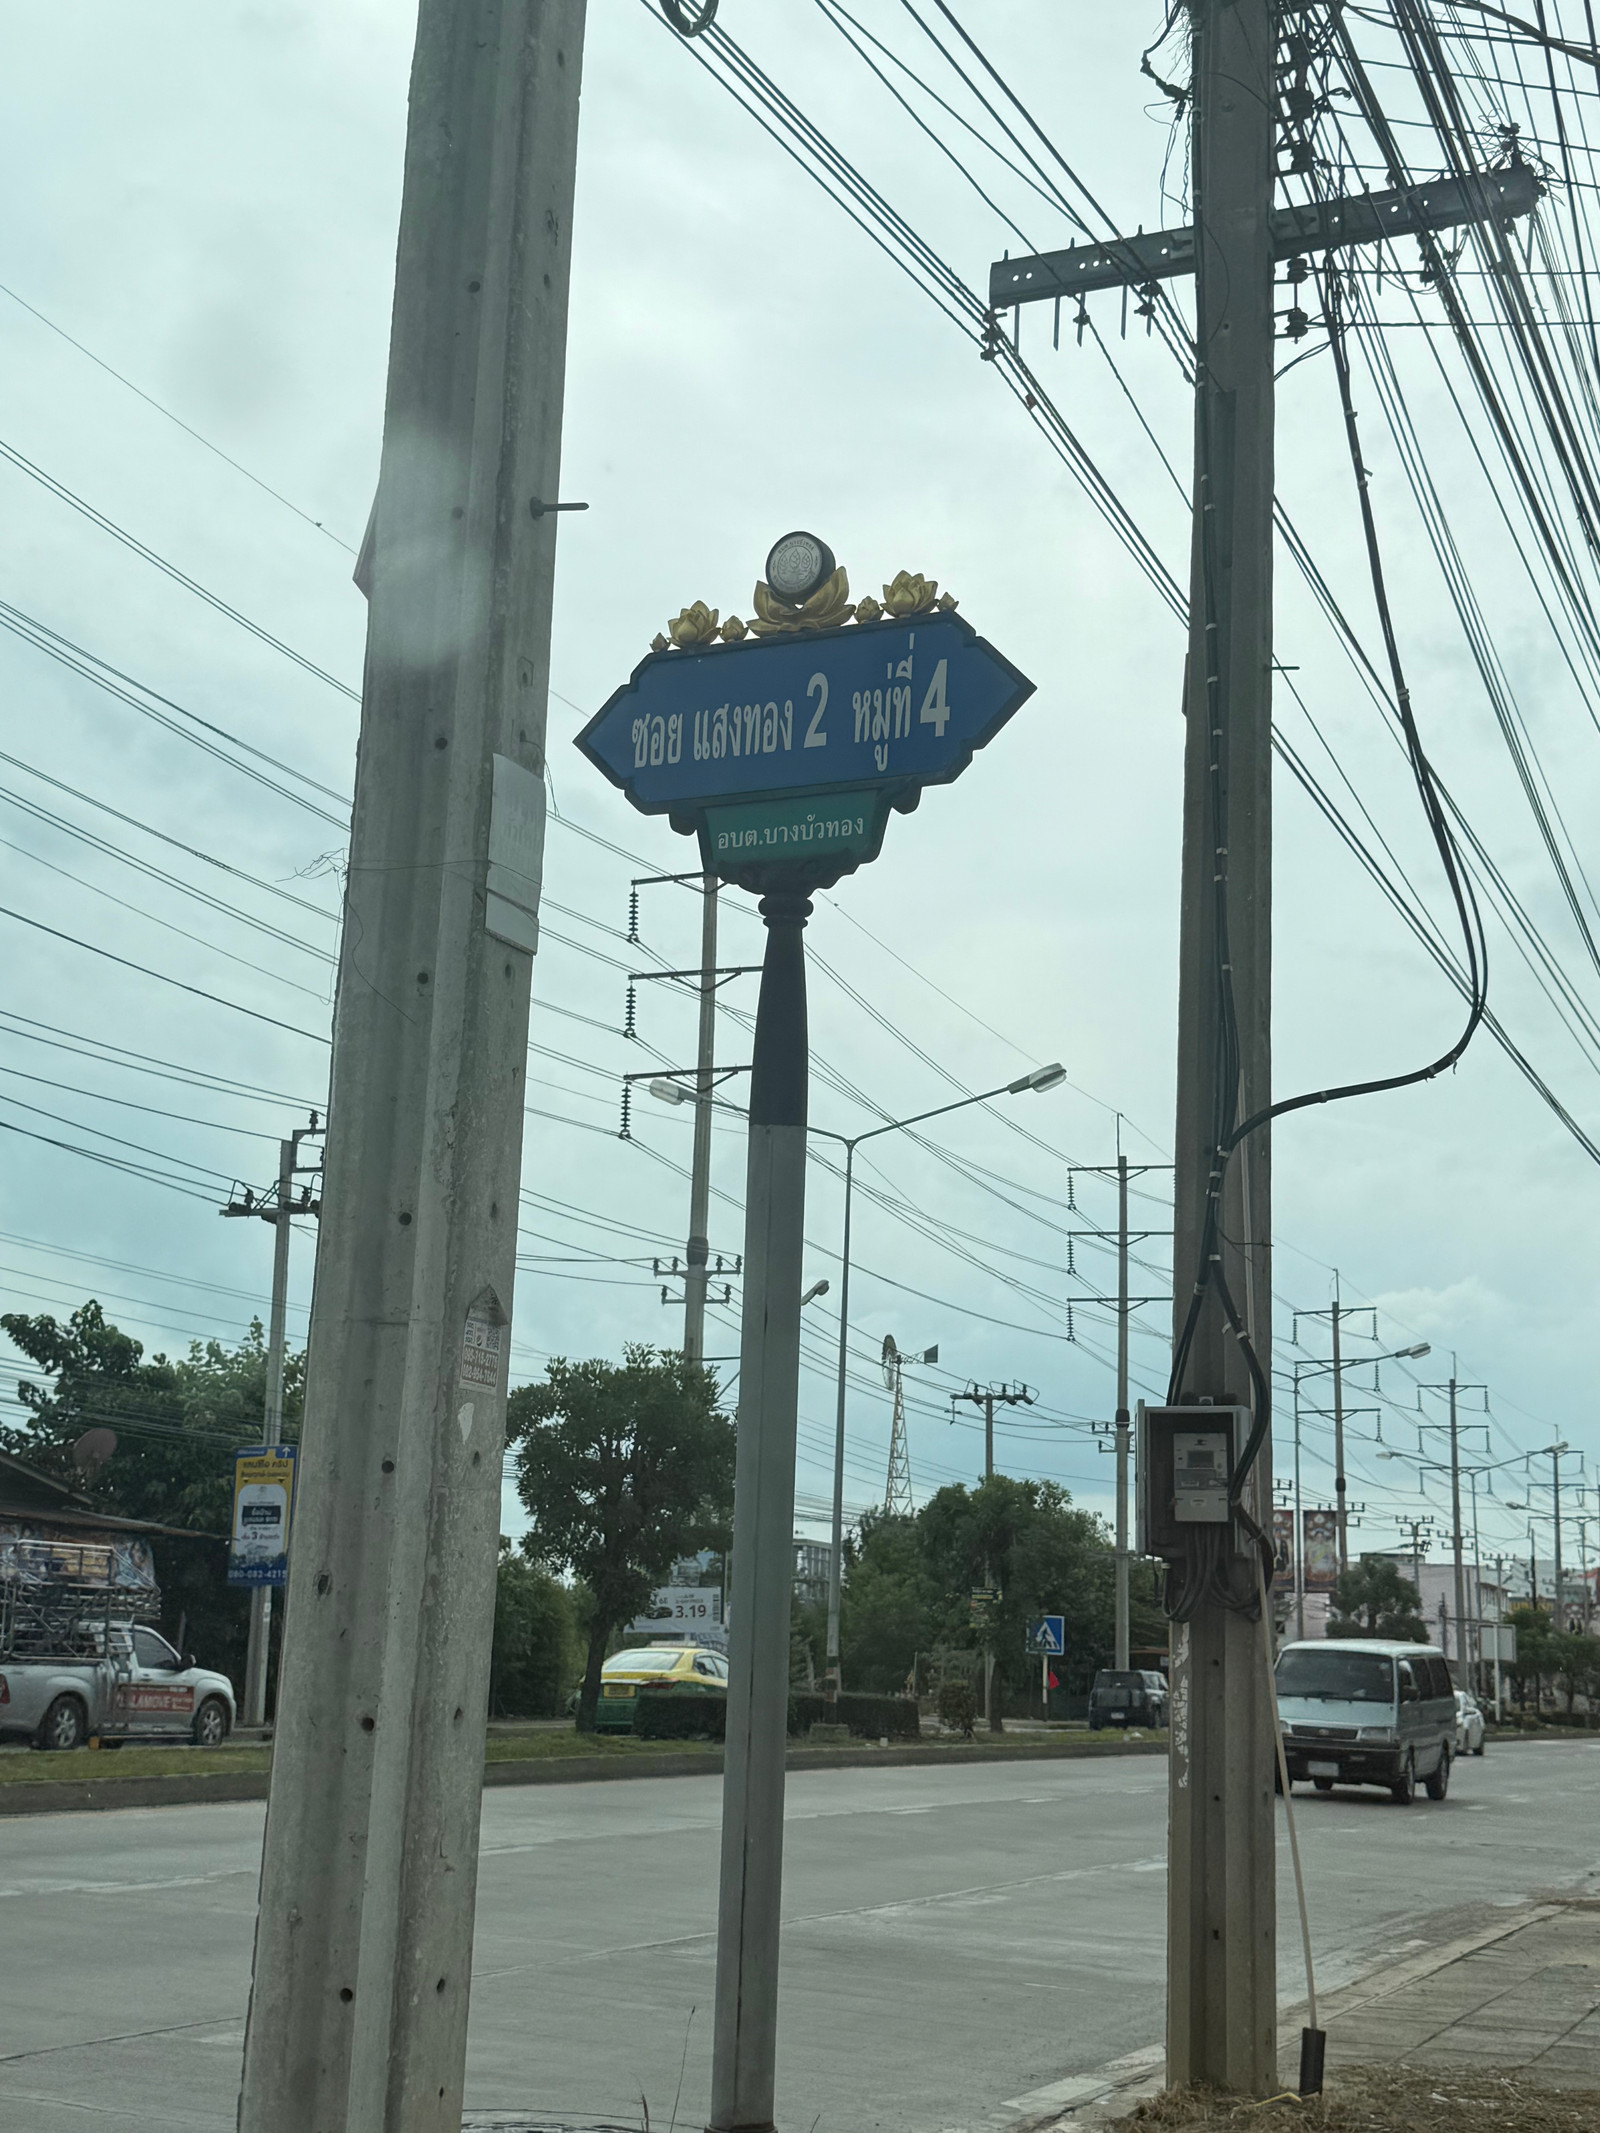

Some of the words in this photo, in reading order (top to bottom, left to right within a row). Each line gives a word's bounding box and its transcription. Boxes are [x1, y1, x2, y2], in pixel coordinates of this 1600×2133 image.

[631, 712, 683, 769] ซอย
[693, 699, 793, 761] แสงทอง
[803, 672, 829, 749] 2
[852, 632, 915, 772] หมู่ที่
[920, 659, 950, 737] 4
[717, 813, 864, 849] อบต.บางบัวทอง
[675, 1604, 706, 1618] 3.19
